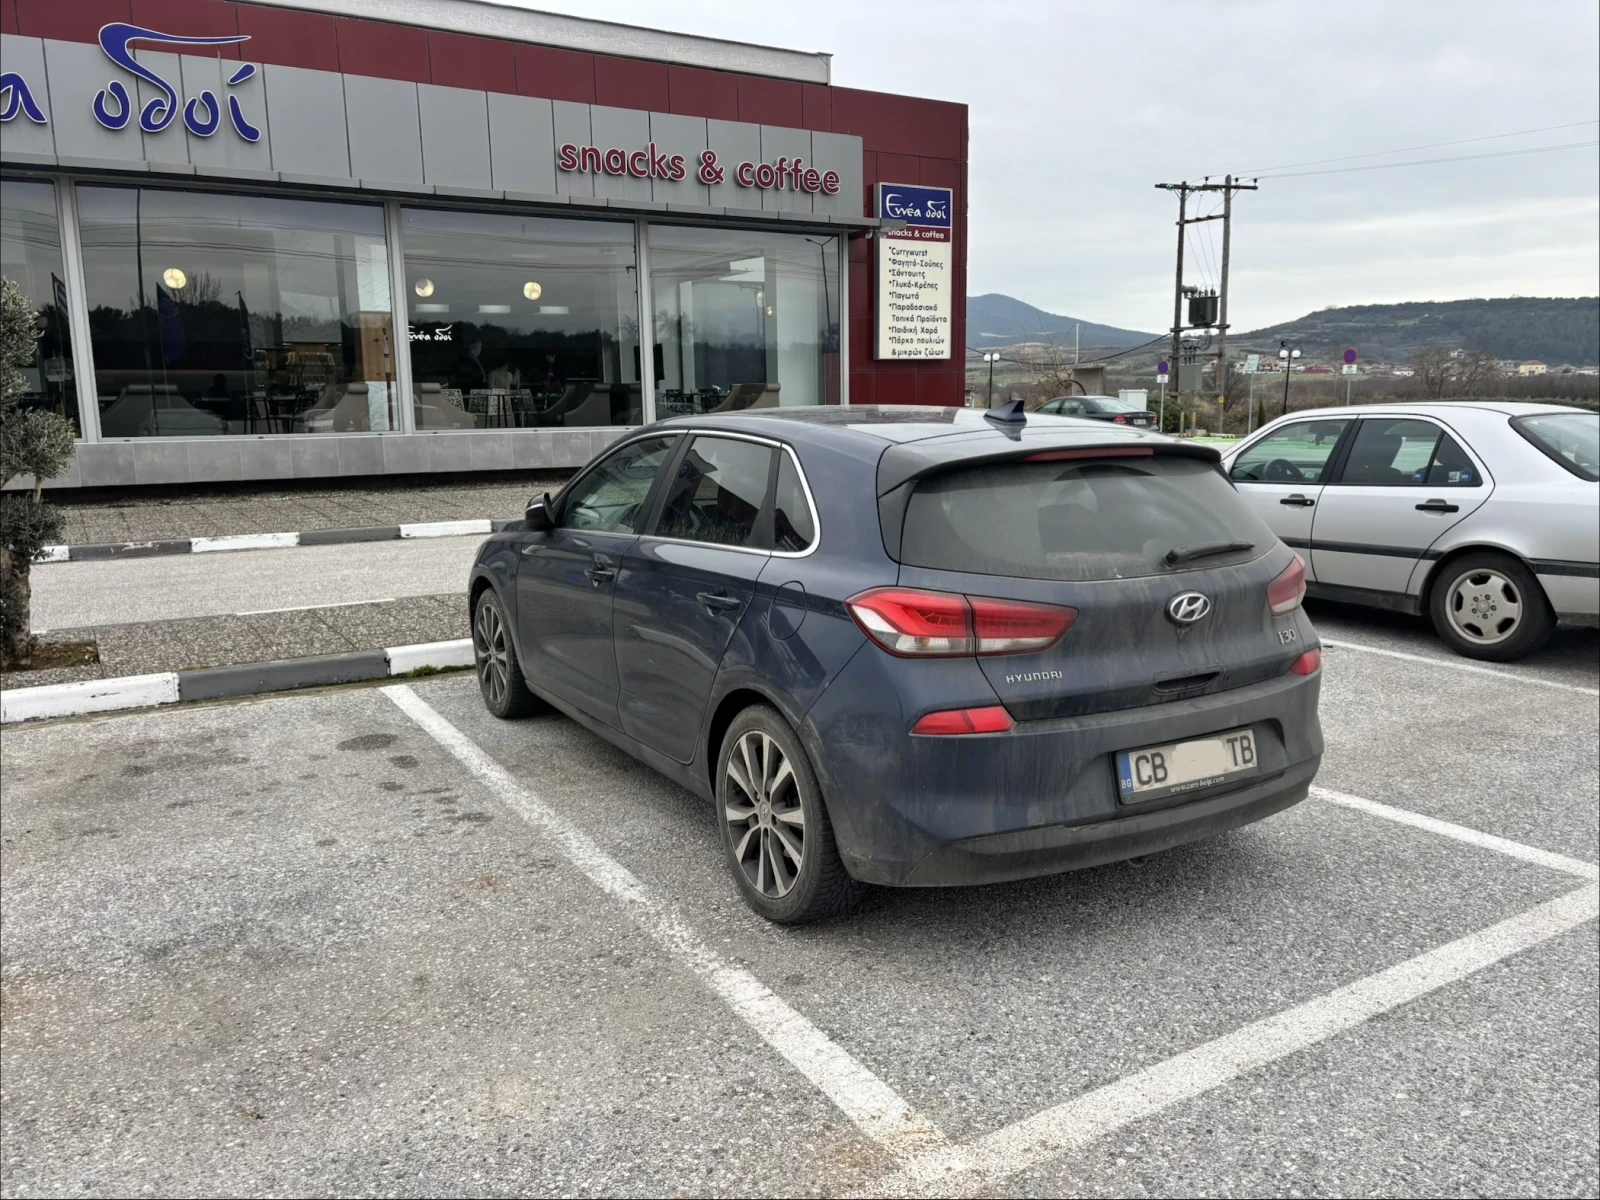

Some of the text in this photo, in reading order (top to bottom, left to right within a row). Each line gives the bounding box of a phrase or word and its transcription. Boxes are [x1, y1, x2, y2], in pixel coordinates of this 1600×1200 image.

[559, 142, 840, 194] snacks & coffee
[914, 229, 920, 237] &
[922, 230, 945, 239] coffee
[1005, 670, 1063, 684] HYUNDAI
